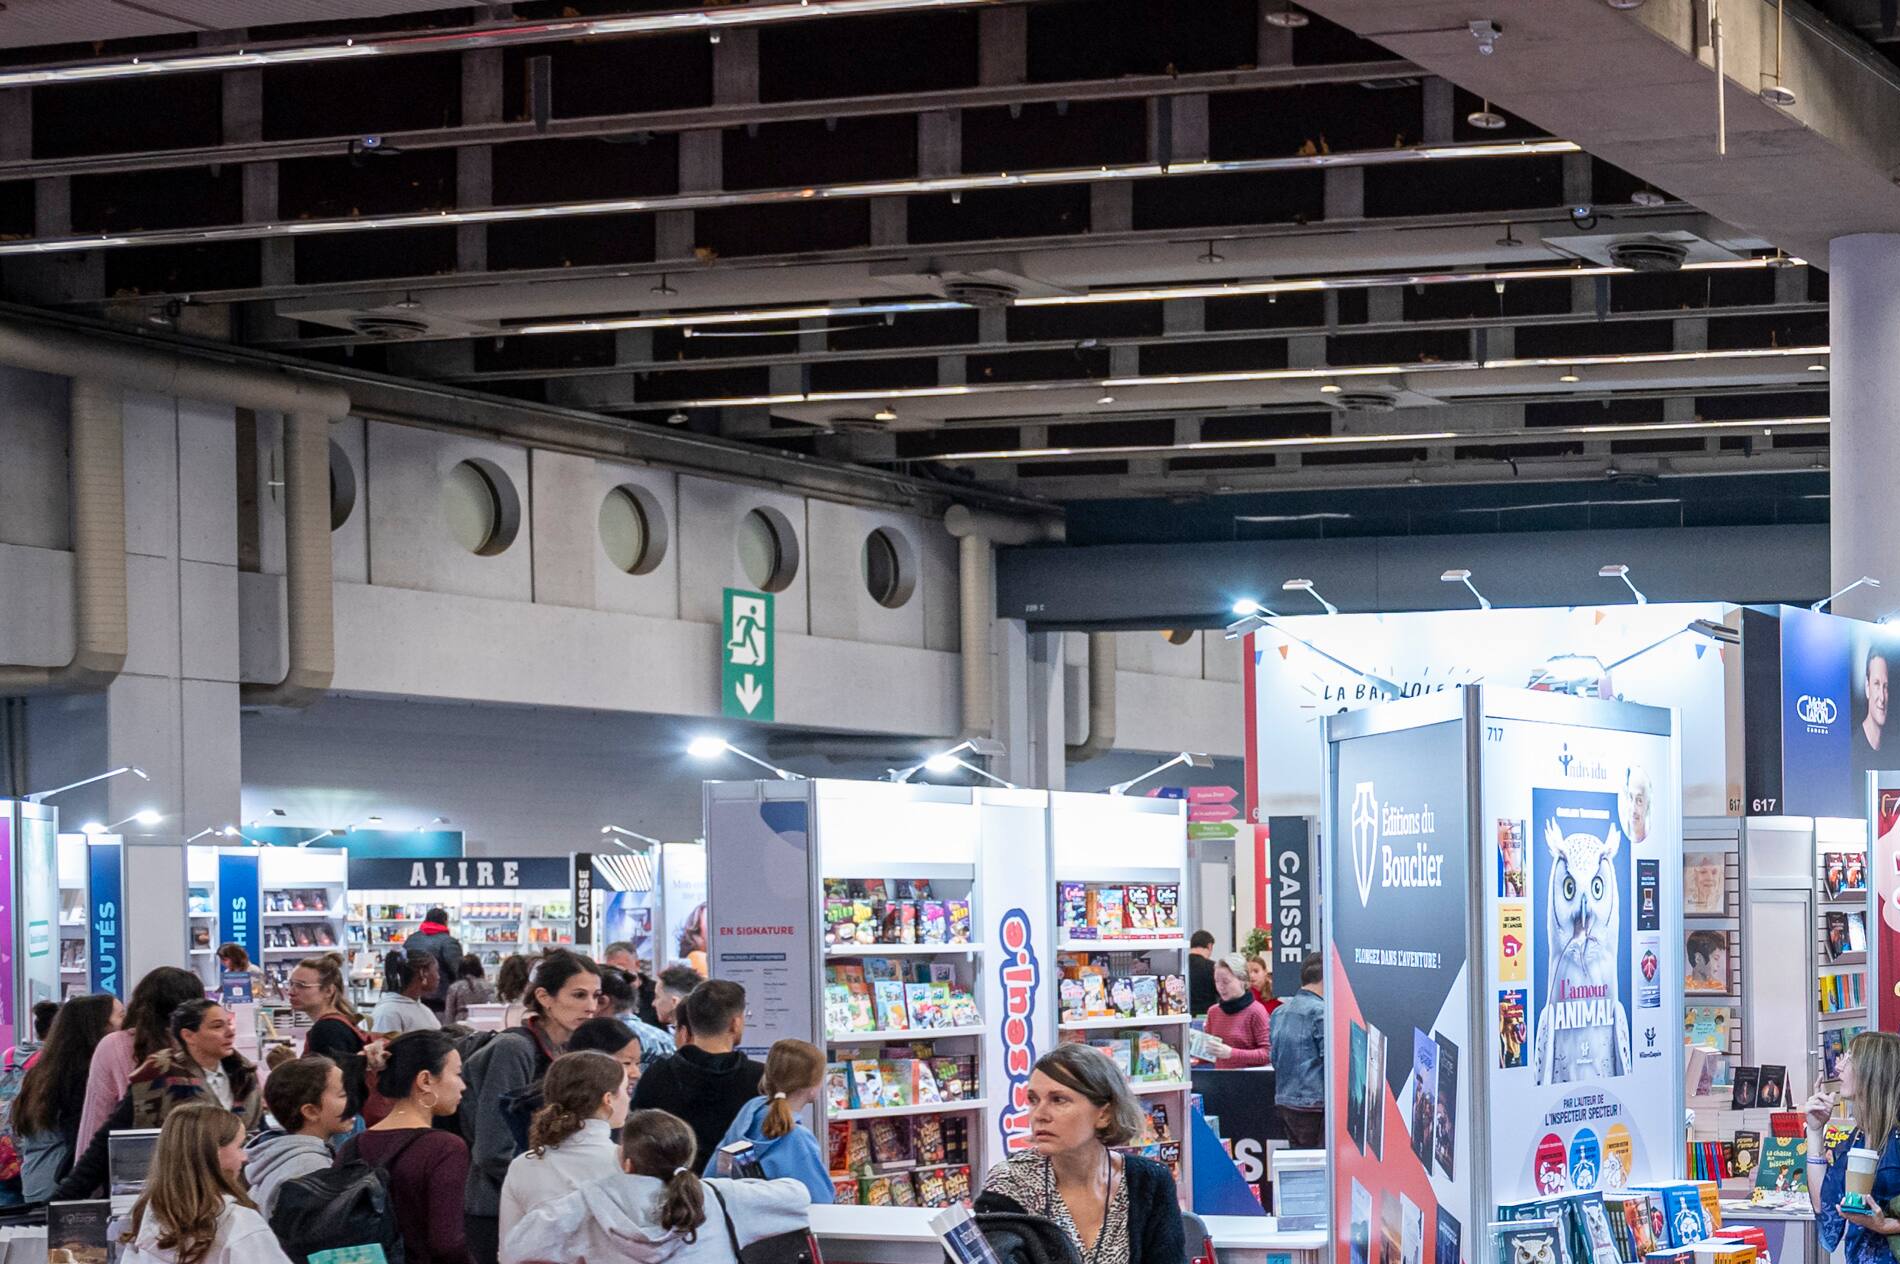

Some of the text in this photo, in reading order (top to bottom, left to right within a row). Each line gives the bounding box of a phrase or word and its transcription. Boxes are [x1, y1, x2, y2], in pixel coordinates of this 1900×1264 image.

[1324, 684, 1345, 701] LA
[1487, 727, 1504, 742] 717
[1729, 799, 1741, 811] 617
[1752, 798, 1777, 812] 617
[1381, 802, 1435, 837] Éditions du
[409, 861, 519, 887] ALIRE
[1381, 842, 1444, 888] Bouclier
[578, 869, 590, 928] CAISSE
[1278, 850, 1302, 963] CAISSE
[720, 926, 795, 936] EN SIGNATURE
[1380, 950, 1397, 966] DANS
[1559, 978, 1609, 1001] L'amour
[1554, 998, 1616, 1031] ANIMAL
[1563, 1097, 1574, 1109] PAR
[1597, 1094, 1605, 1104] DE
[1545, 1104, 1618, 1126] L'INSPECTEUR SPECTEUR
